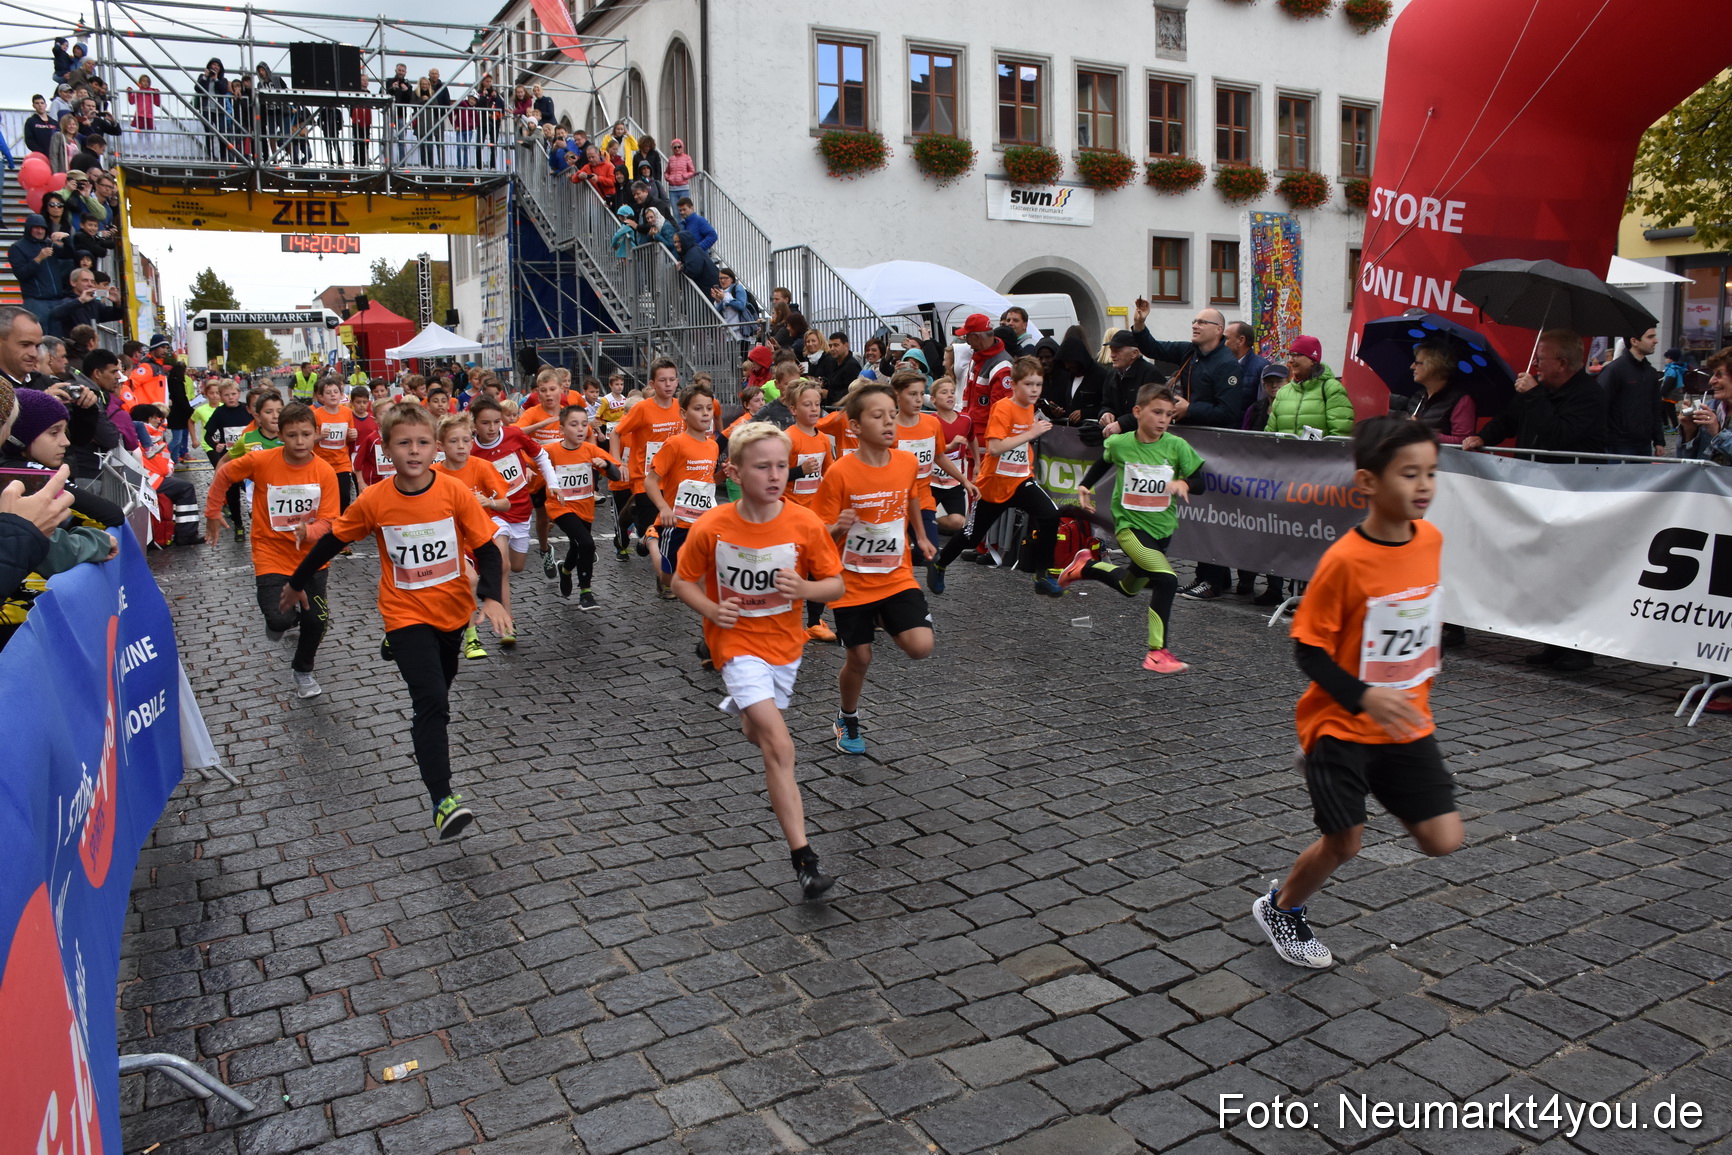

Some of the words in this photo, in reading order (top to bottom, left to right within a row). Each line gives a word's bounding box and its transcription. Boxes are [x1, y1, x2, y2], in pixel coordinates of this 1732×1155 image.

[1010, 189, 1053, 207] swn
[149, 208, 192, 217] Neumarkter
[193, 210, 228, 218] Stadtlauf
[272, 200, 350, 226] ZIEL
[430, 214, 461, 222] Stadtlauf
[1010, 205, 1038, 213] stadtwerke
[1039, 207, 1064, 215] neumarkt
[1371, 186, 1466, 234] STORE
[219, 313, 247, 323] MINI
[500, 465, 518, 481] 06
[562, 473, 588, 487] 7076
[1131, 477, 1166, 494] 7200
[683, 493, 712, 508] 7058
[1286, 481, 1368, 509] LOUNG
[276, 498, 313, 513] 7183
[1176, 504, 1336, 541] ww.bockonline.de
[856, 535, 897, 553] 7124
[396, 540, 448, 565] 7182
[417, 569, 433, 577] Luis
[741, 597, 766, 605] Lukas
[1630, 597, 1732, 629] stadtw
